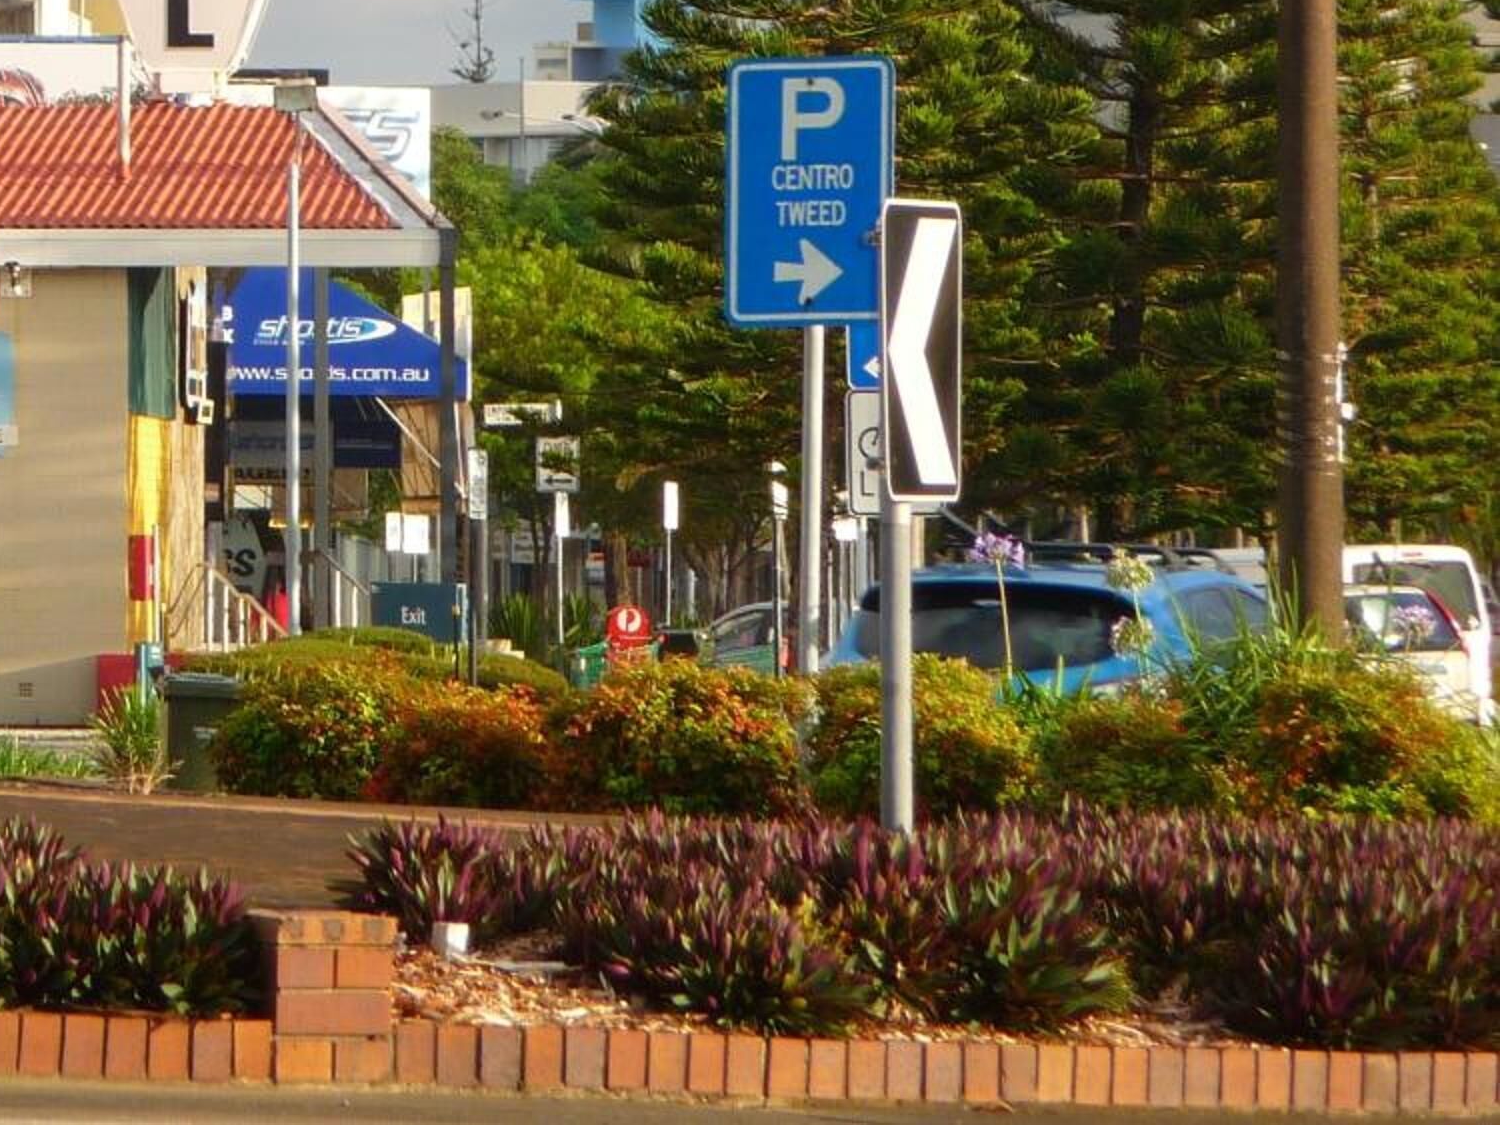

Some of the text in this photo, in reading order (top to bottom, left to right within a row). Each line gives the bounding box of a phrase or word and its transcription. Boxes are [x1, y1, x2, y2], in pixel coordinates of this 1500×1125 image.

[781, 77, 846, 160] P
[771, 164, 854, 191] CENTRO
[775, 200, 846, 227] TWEED
[401, 605, 427, 625] Exit
